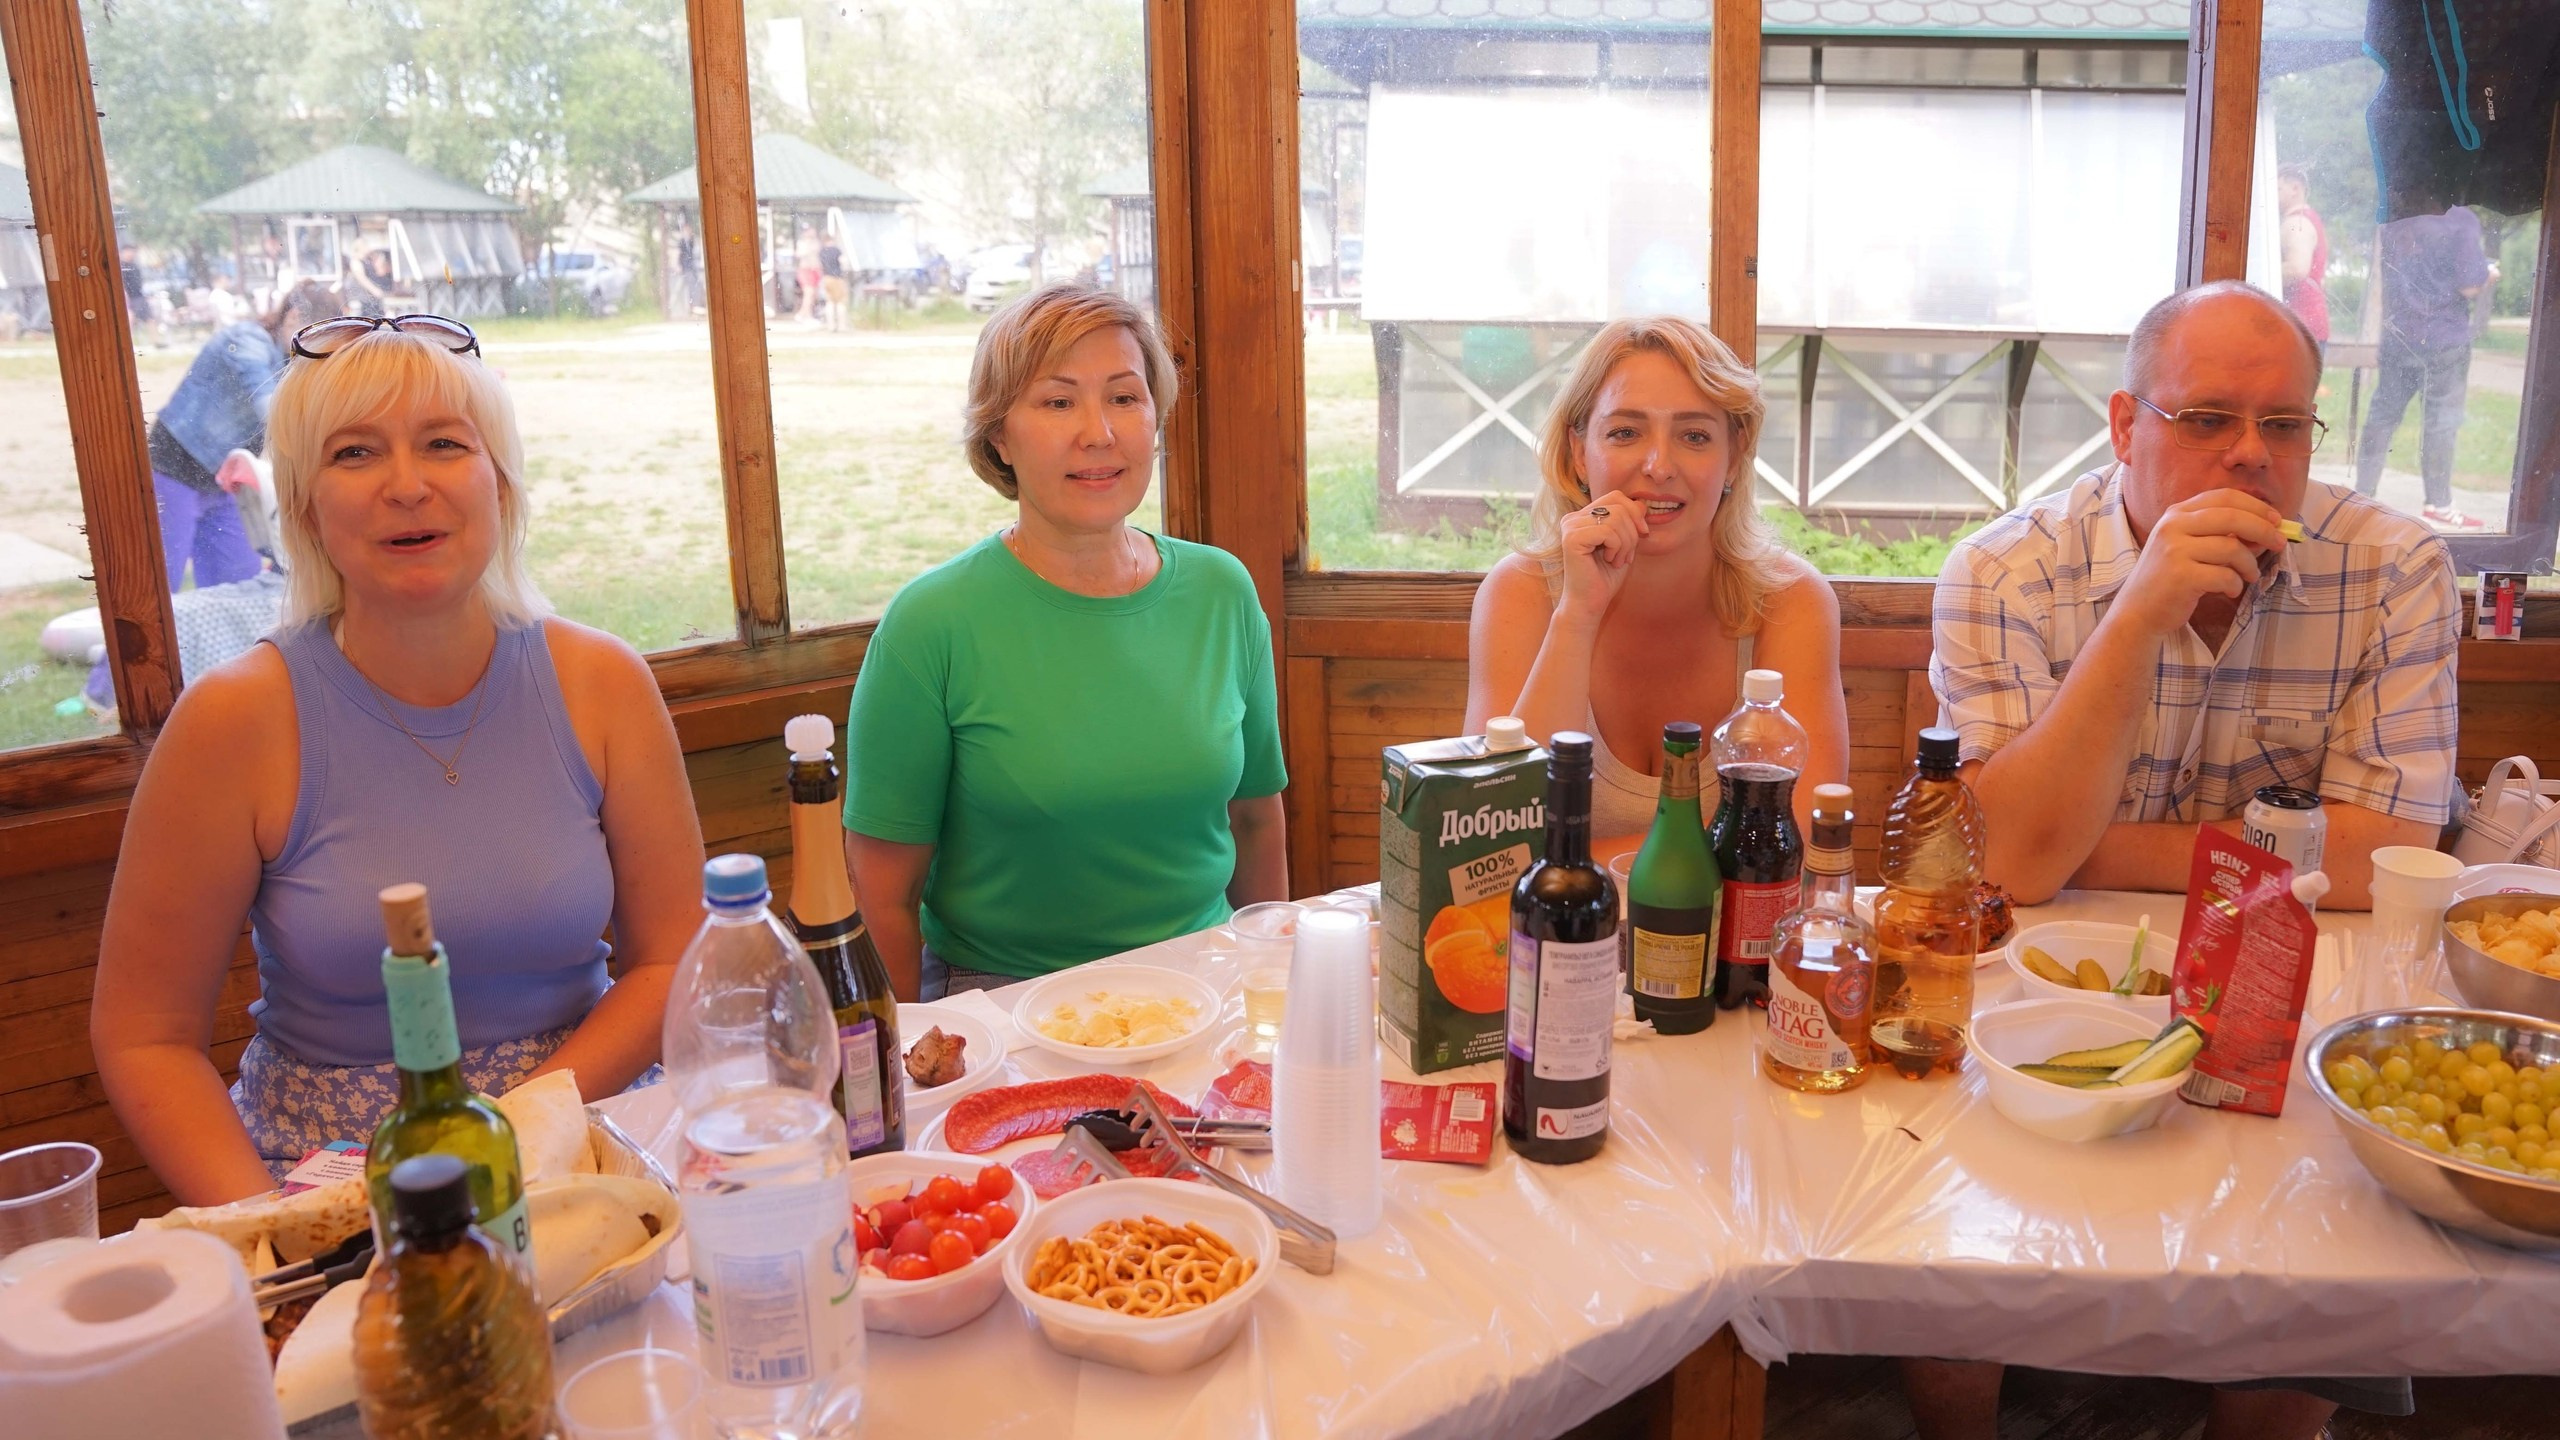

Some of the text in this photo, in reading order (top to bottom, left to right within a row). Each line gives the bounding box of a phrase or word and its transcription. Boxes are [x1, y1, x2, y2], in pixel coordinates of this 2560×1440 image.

[2487, 97, 2496, 120] JOSS
[1473, 774, 1517, 789] апельсин
[1439, 797, 1544, 848] Добрый
[1465, 851, 1515, 880] 100%
[2210, 850, 2251, 877] HEINZ
[1465, 867, 1519, 891] НАТУРАЛЬНЫЕ
[1478, 880, 1511, 895] ФРУКТЫ
[2211, 876, 2243, 896] ОСТРЫЙ
[2215, 870, 2241, 885] СУПЕР
[1776, 992, 1818, 1016] NOBLE
[1771, 1002, 1825, 1039] STAG
[1468, 1035, 1504, 1047] ВИТАМИН
[1784, 1034, 1829, 1049] SCOTCH WHISKY
